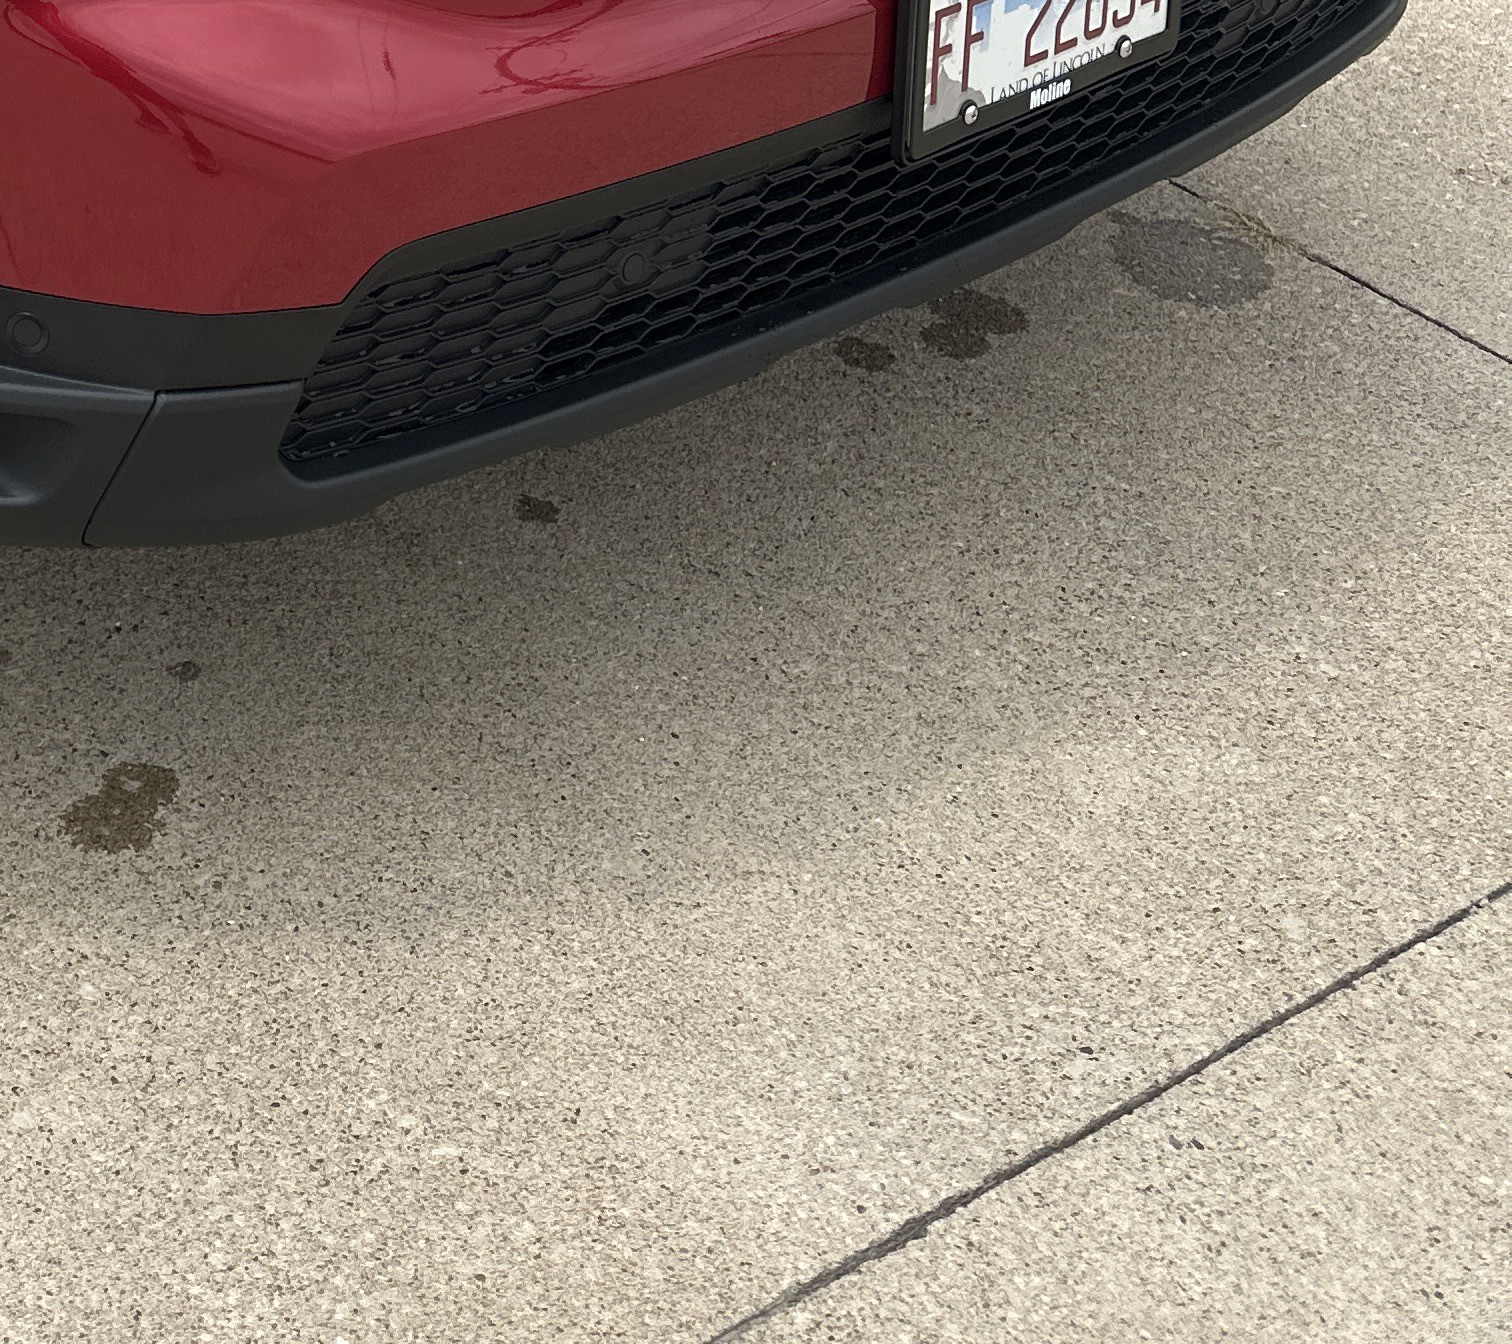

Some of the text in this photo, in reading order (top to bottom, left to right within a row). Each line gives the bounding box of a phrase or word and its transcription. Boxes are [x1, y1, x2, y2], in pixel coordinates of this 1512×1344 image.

[990, 77, 1029, 104] LAND
[1033, 68, 1050, 87] OF
[1029, 78, 1072, 110] Moline
